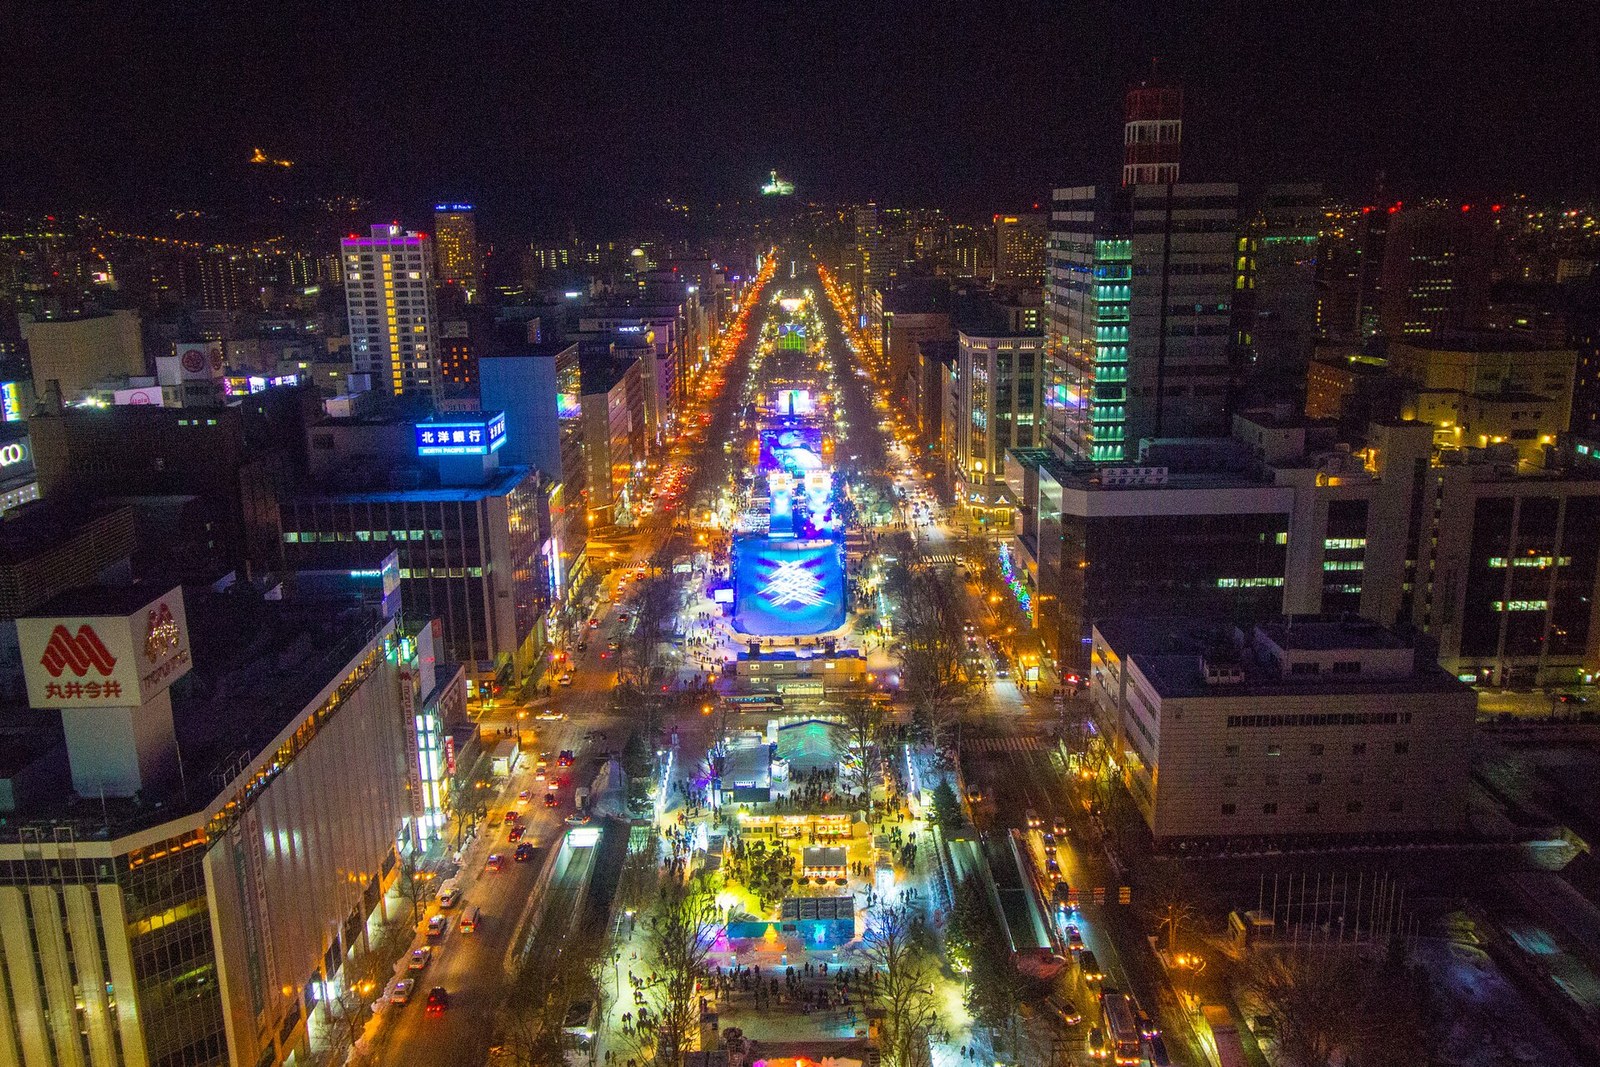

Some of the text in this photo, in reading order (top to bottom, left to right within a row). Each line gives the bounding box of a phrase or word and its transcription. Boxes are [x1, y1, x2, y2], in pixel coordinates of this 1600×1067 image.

[421, 430, 481, 443] 北洋銀行
[46, 681, 122, 699] 丸井今井
